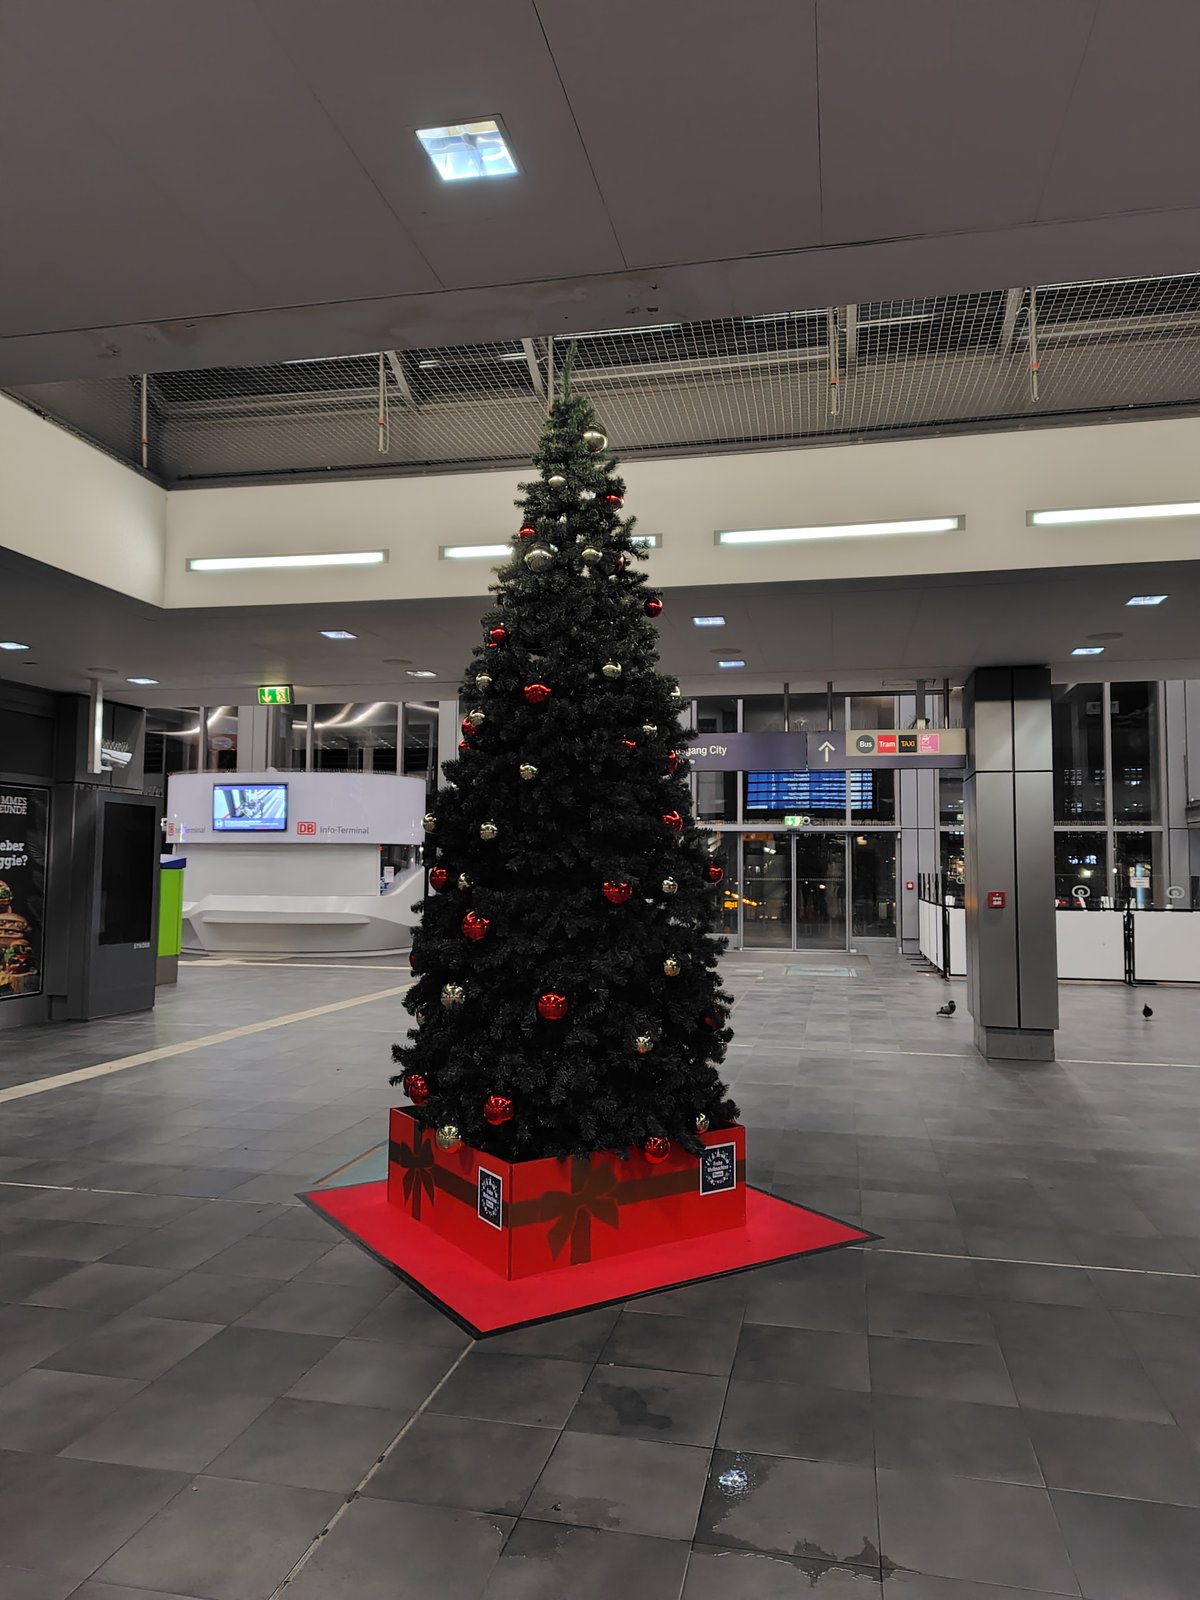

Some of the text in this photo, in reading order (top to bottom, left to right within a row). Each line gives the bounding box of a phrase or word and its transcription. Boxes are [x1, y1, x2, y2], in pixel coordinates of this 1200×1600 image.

[901, 740, 916, 748] TAXI
[710, 745, 727, 756] City
[320, 826, 369, 834] Info-Terminal
[0, 840, 25, 851] eber
